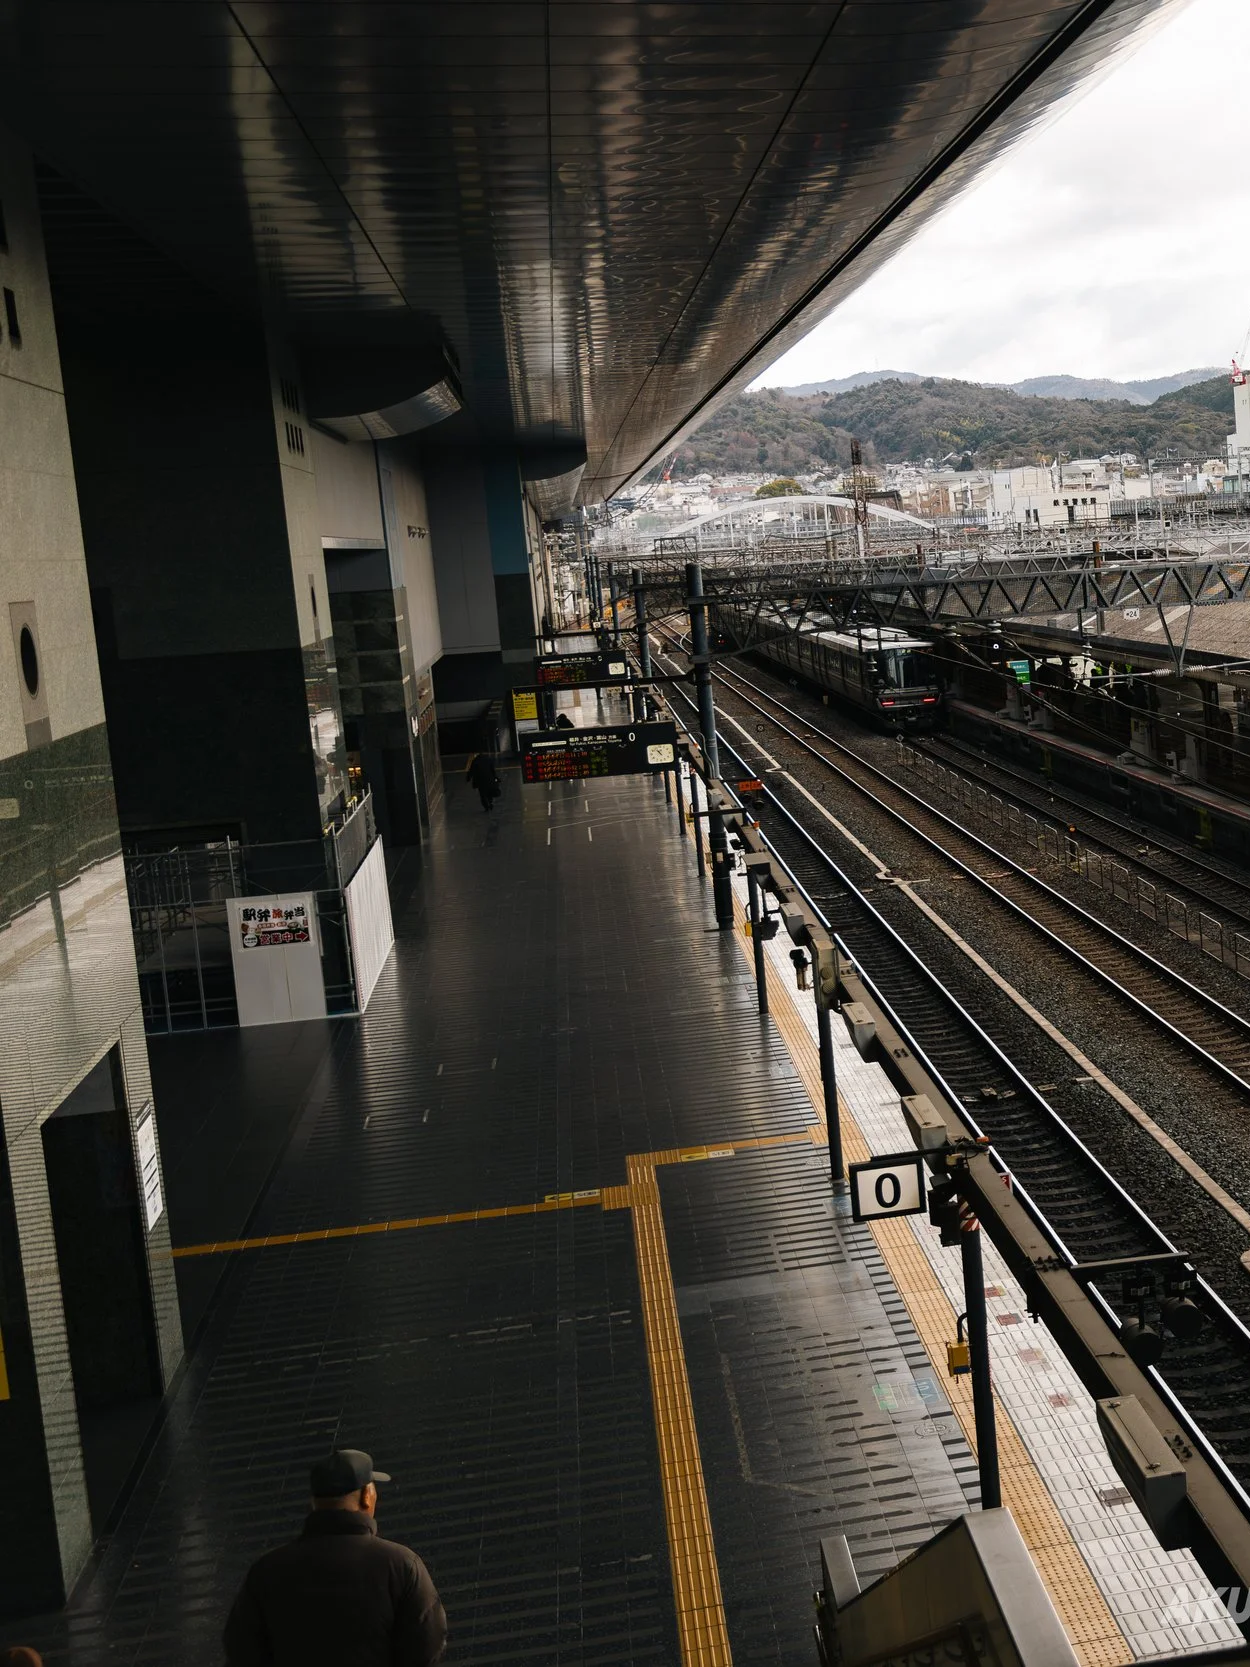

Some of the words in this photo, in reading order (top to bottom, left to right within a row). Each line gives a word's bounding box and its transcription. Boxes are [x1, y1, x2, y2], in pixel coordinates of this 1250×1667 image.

[628, 732, 636, 742] 0
[259, 931, 294, 945] 営業中
[874, 1172, 902, 1208] 0
